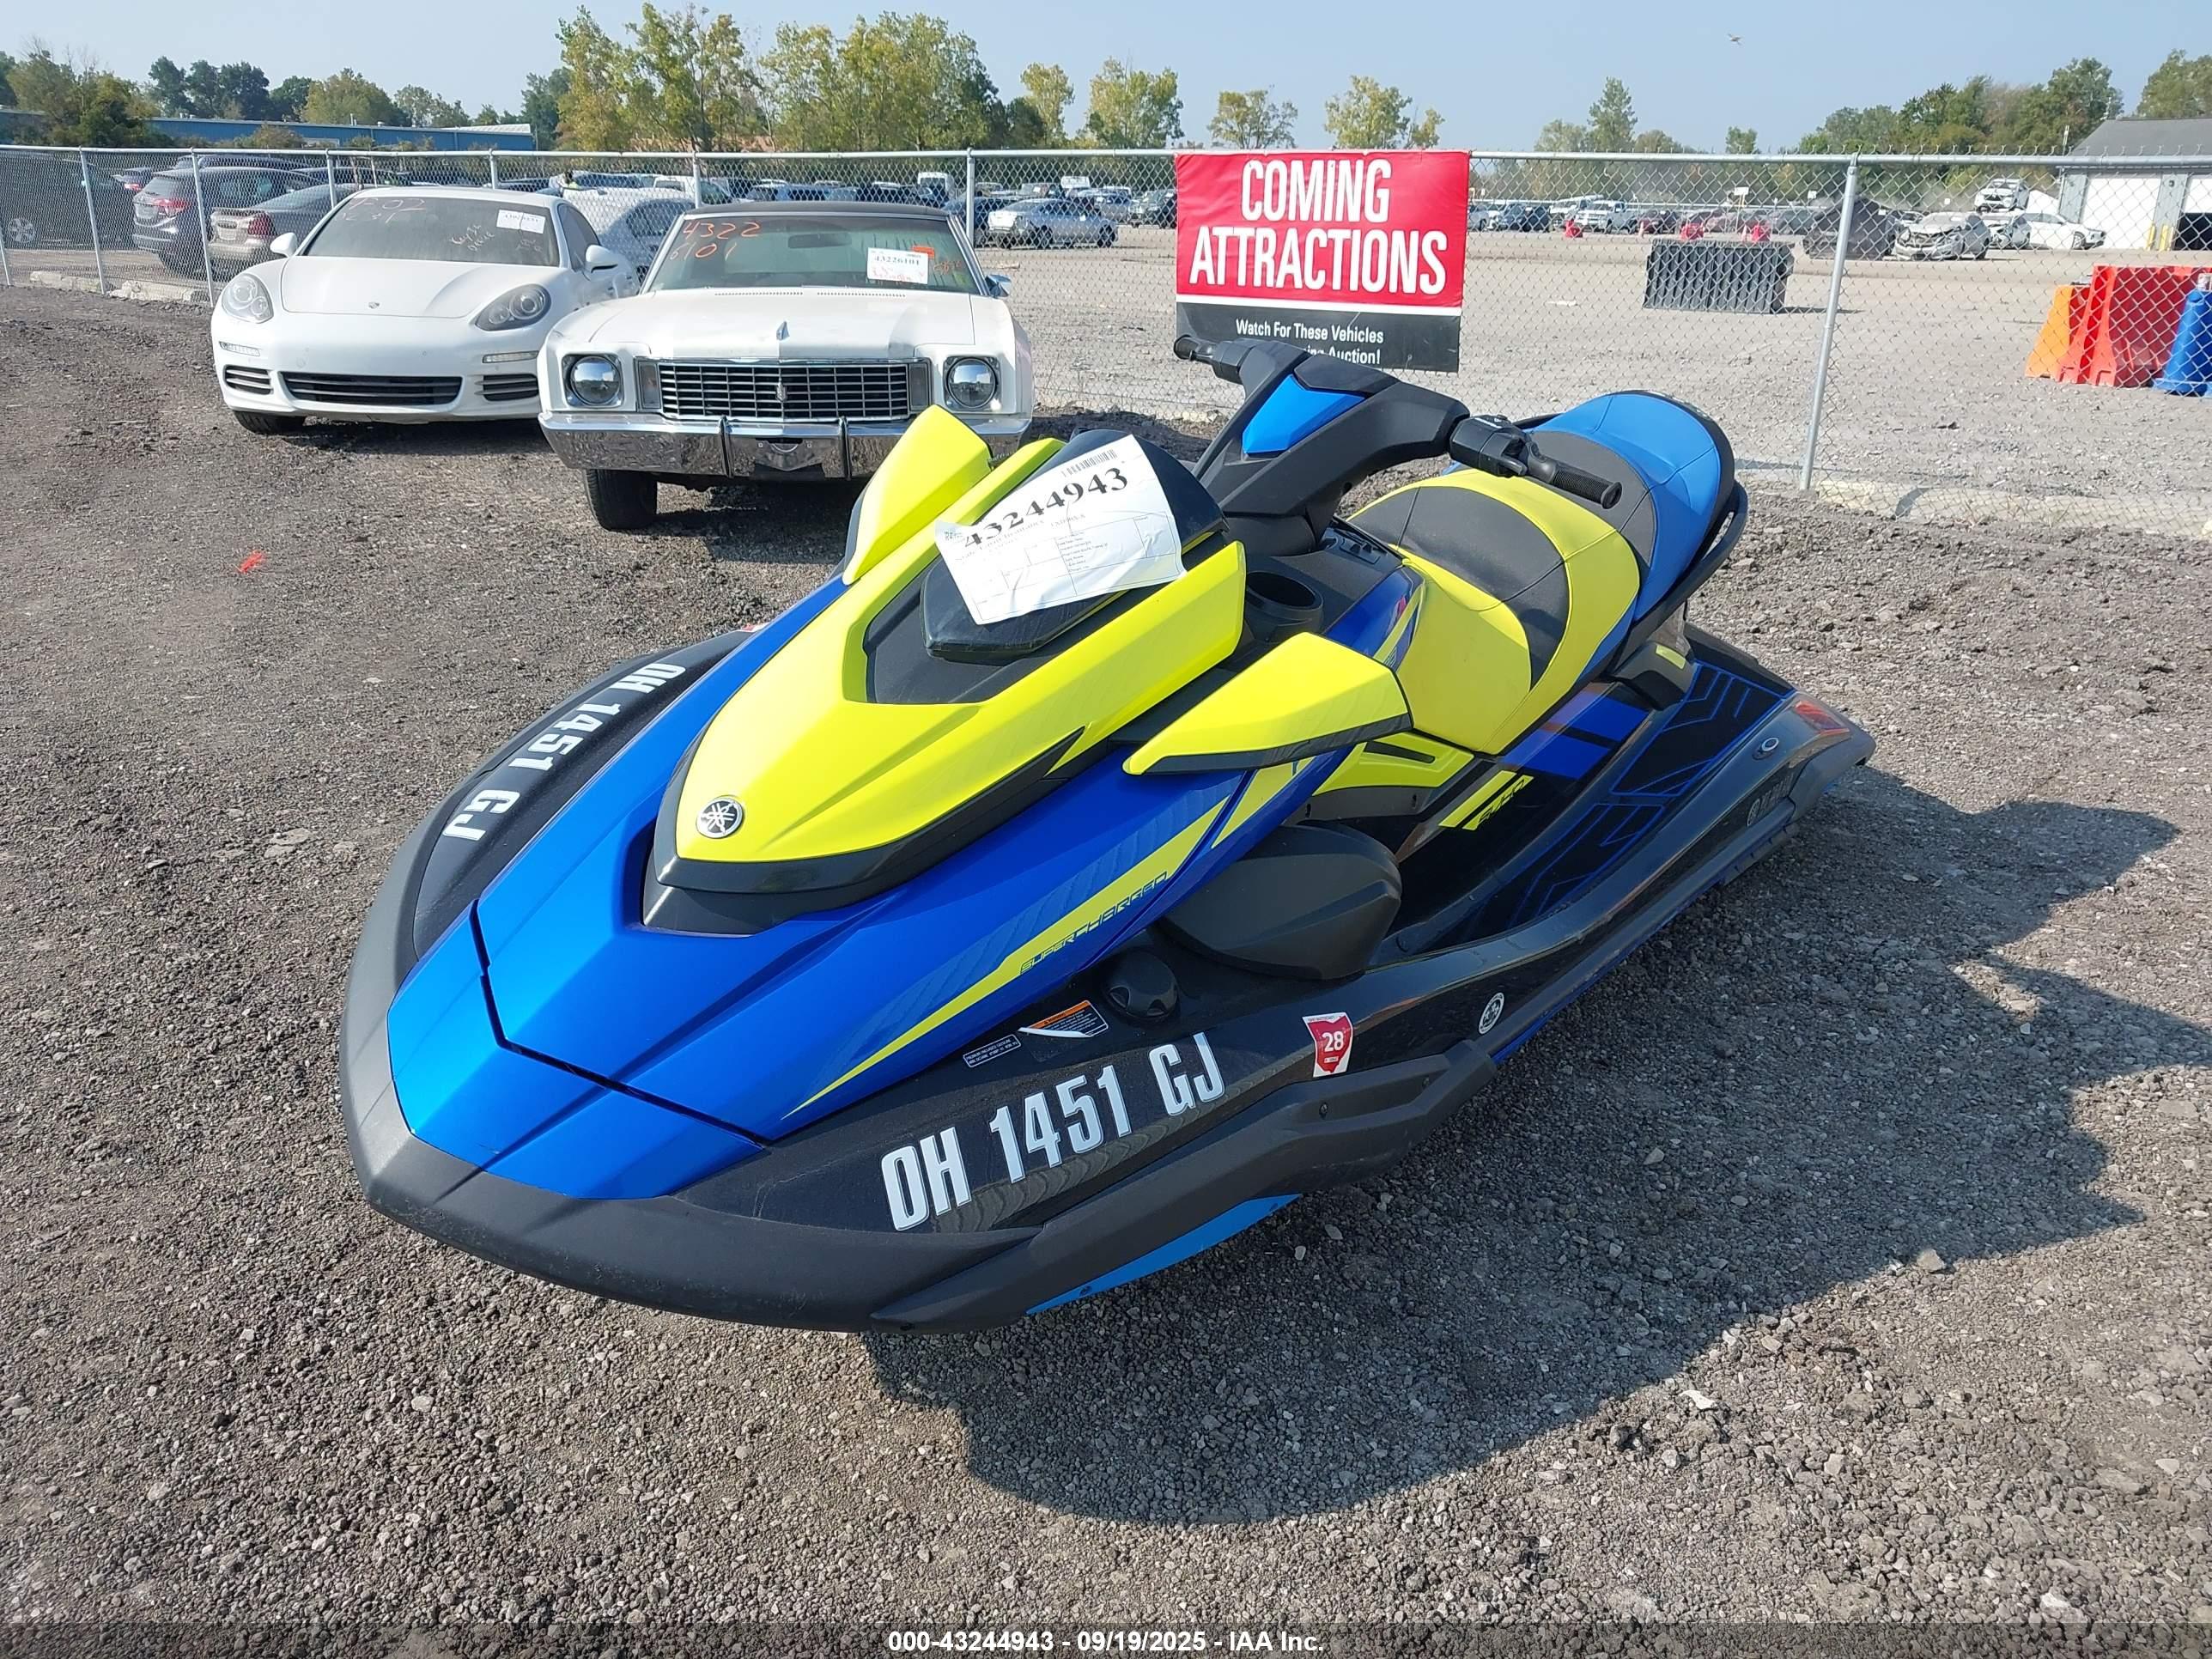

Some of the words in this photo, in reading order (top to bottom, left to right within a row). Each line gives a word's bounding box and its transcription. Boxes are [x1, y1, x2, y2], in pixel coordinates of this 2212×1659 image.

[1242, 159, 1392, 222] COMING
[683, 221, 760, 240] 4322
[1189, 226, 1448, 295] ATTRACTIONS
[1236, 319, 1271, 337] Watch
[1274, 321, 1291, 338] For
[1293, 323, 1328, 340] These
[1331, 325, 1384, 343] Vehicles
[964, 467, 1128, 548] 43244943
[610, 663, 686, 694] OH
[508, 703, 621, 771] 1451
[442, 789, 520, 841] GJ
[1322, 1030, 1345, 1052] 28
[881, 1127, 972, 1231] OH
[989, 1065, 1133, 1184] 1451
[1148, 1032, 1226, 1116] GJ
